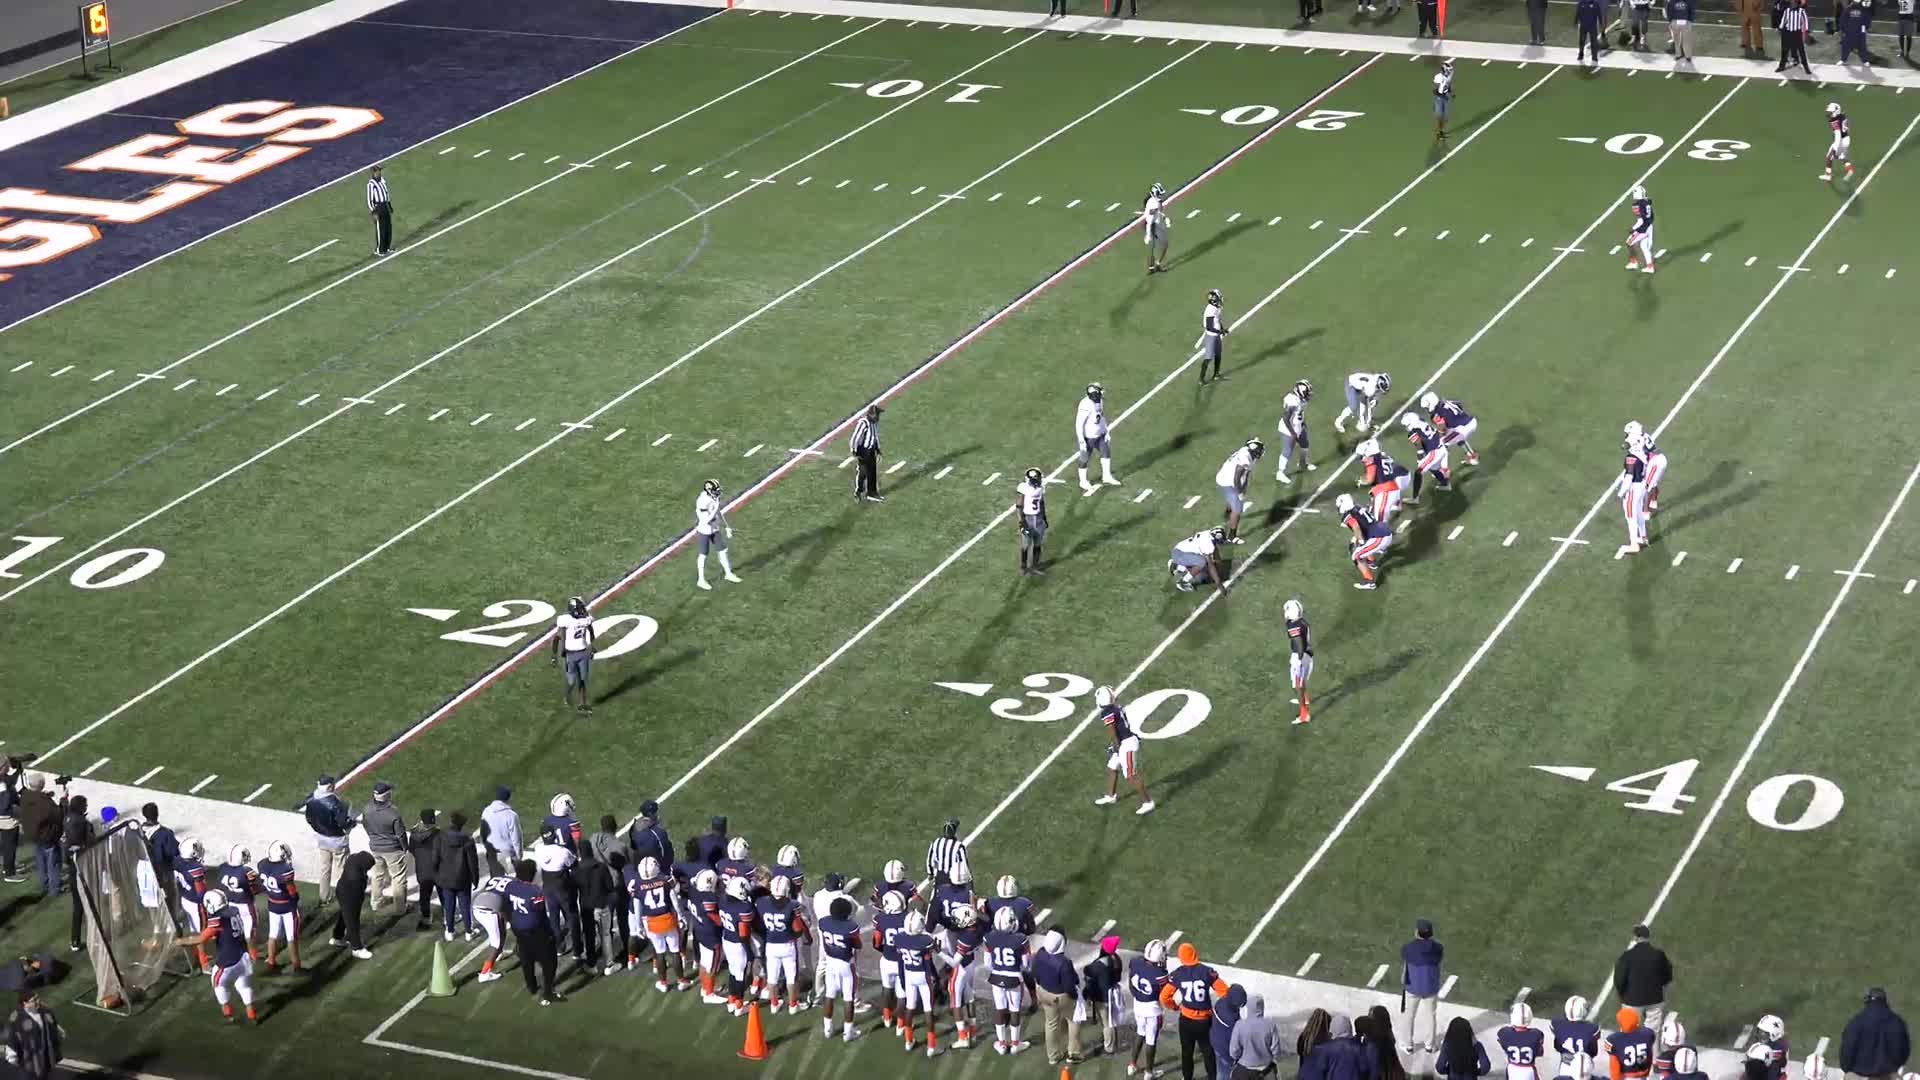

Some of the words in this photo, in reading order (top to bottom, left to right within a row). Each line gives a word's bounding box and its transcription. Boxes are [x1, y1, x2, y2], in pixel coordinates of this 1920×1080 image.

[88, 4, 107, 34] 6
[866, 79, 1003, 103] 10
[1220, 104, 1366, 131] 20
[1604, 133, 1752, 161] 30
[0, 99, 385, 268] GLES
[0, 535, 166, 589] 10
[439, 599, 659, 660] 20
[990, 672, 1212, 739] 30
[1601, 758, 1845, 831] 40
[485, 876, 512, 892] 58
[643, 886, 666, 910] 47
[763, 912, 787, 932] 65
[993, 947, 1016, 966] 16
[1181, 980, 1206, 1003] 76
[1507, 1045, 1534, 1065] 33
[1624, 1043, 1648, 1067] 35
